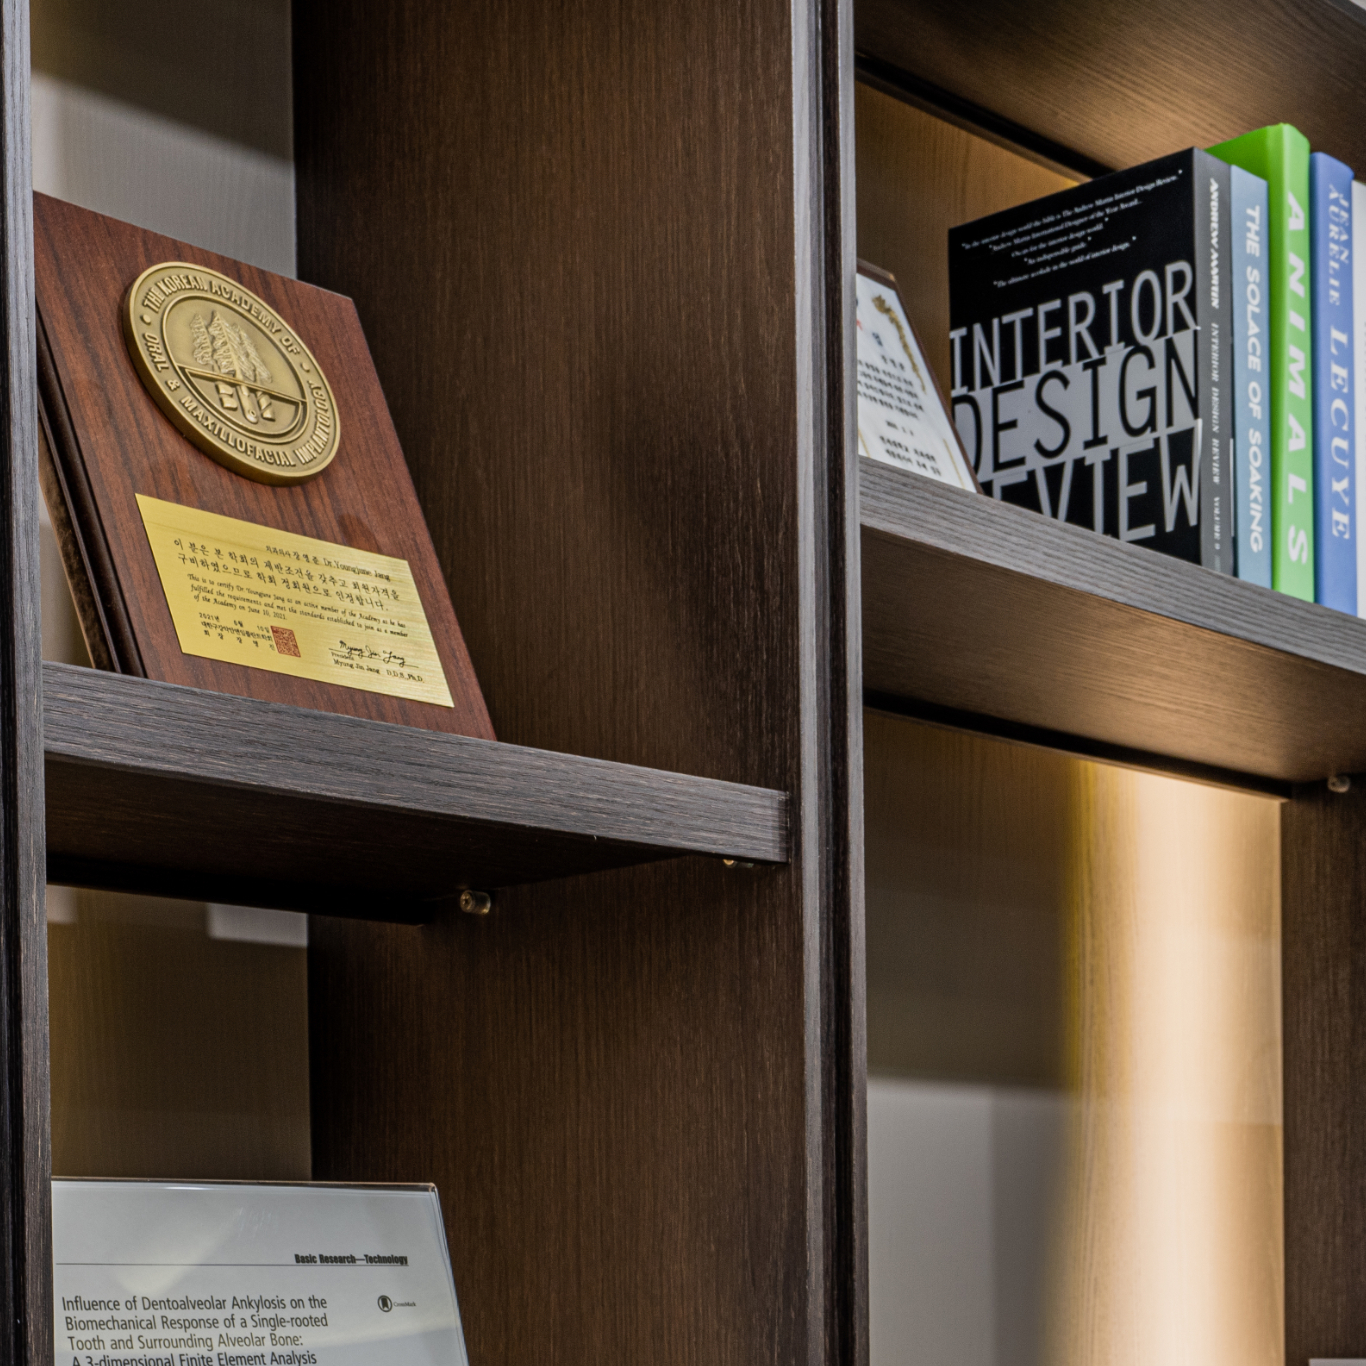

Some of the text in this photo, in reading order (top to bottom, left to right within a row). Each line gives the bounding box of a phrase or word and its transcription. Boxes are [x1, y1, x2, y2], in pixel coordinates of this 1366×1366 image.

[1339, 193, 1349, 264] JEAN
[143, 274, 300, 356] THE KOREAN ACADEMY OF
[949, 260, 1200, 396] INTERIOR
[1211, 323, 1219, 382] INTERIOR
[1245, 205, 1263, 553] THE SOLACE OF SOAKING
[1288, 190, 1308, 564] ANIMALS
[143, 332, 331, 466] ORAL & MAXILLOFACIAL IMPLANTOLOGY
[951, 333, 1201, 484] DESIGN
[1211, 387, 1220, 434] DESIGN
[992, 418, 1202, 542] VIEW
[1212, 438, 1220, 485] REVIEW
[174, 538, 183, 550] 이
[189, 542, 209, 556] 분은
[214, 548, 224, 560] 본
[228, 551, 259, 568] 학회의
[352, 582, 399, 600] 회원자격을
[178, 553, 253, 579] 구비하였으므로
[256, 572, 277, 586] 학회
[281, 578, 332, 598] 정회원으로
[294, 1254, 317, 1264] Basic
[62, 1294, 328, 1313] Influence of Dentoalveolar Ankylosis on the
[65, 1312, 329, 1332] Biomechanical Response of a Single-rooted
[67, 1332, 303, 1352] Tooth and Surrounding Alveolar Bone:
